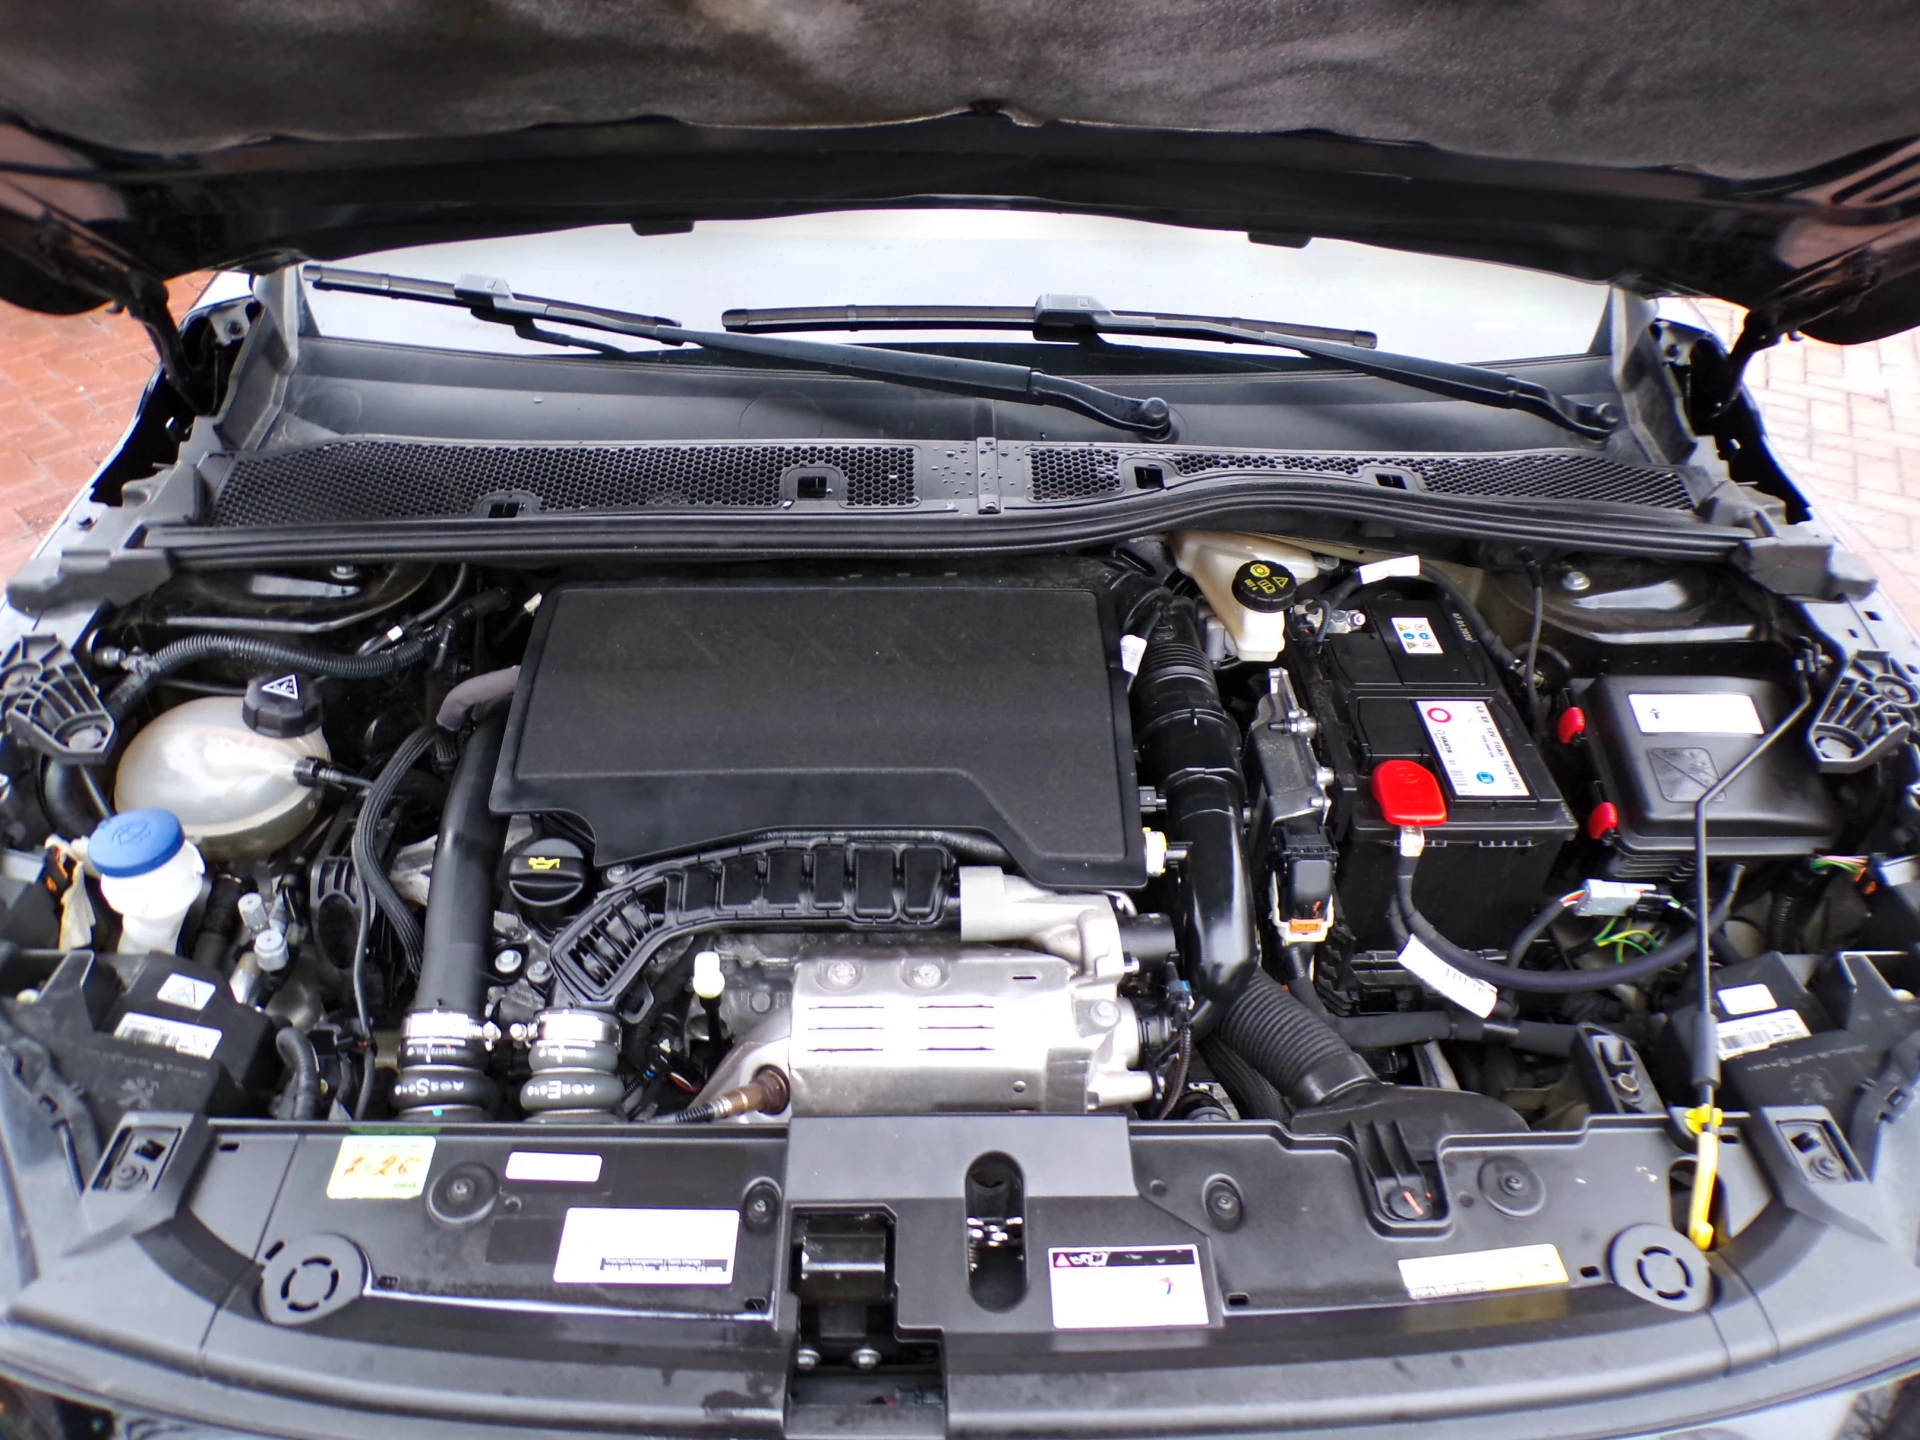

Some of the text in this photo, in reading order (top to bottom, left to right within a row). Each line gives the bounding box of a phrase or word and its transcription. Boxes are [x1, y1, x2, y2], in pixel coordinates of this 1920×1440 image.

[1440, 736, 1452, 753] VARTA
[1487, 727, 1497, 737] 12V
[1493, 741, 1505, 756] 70Ah
